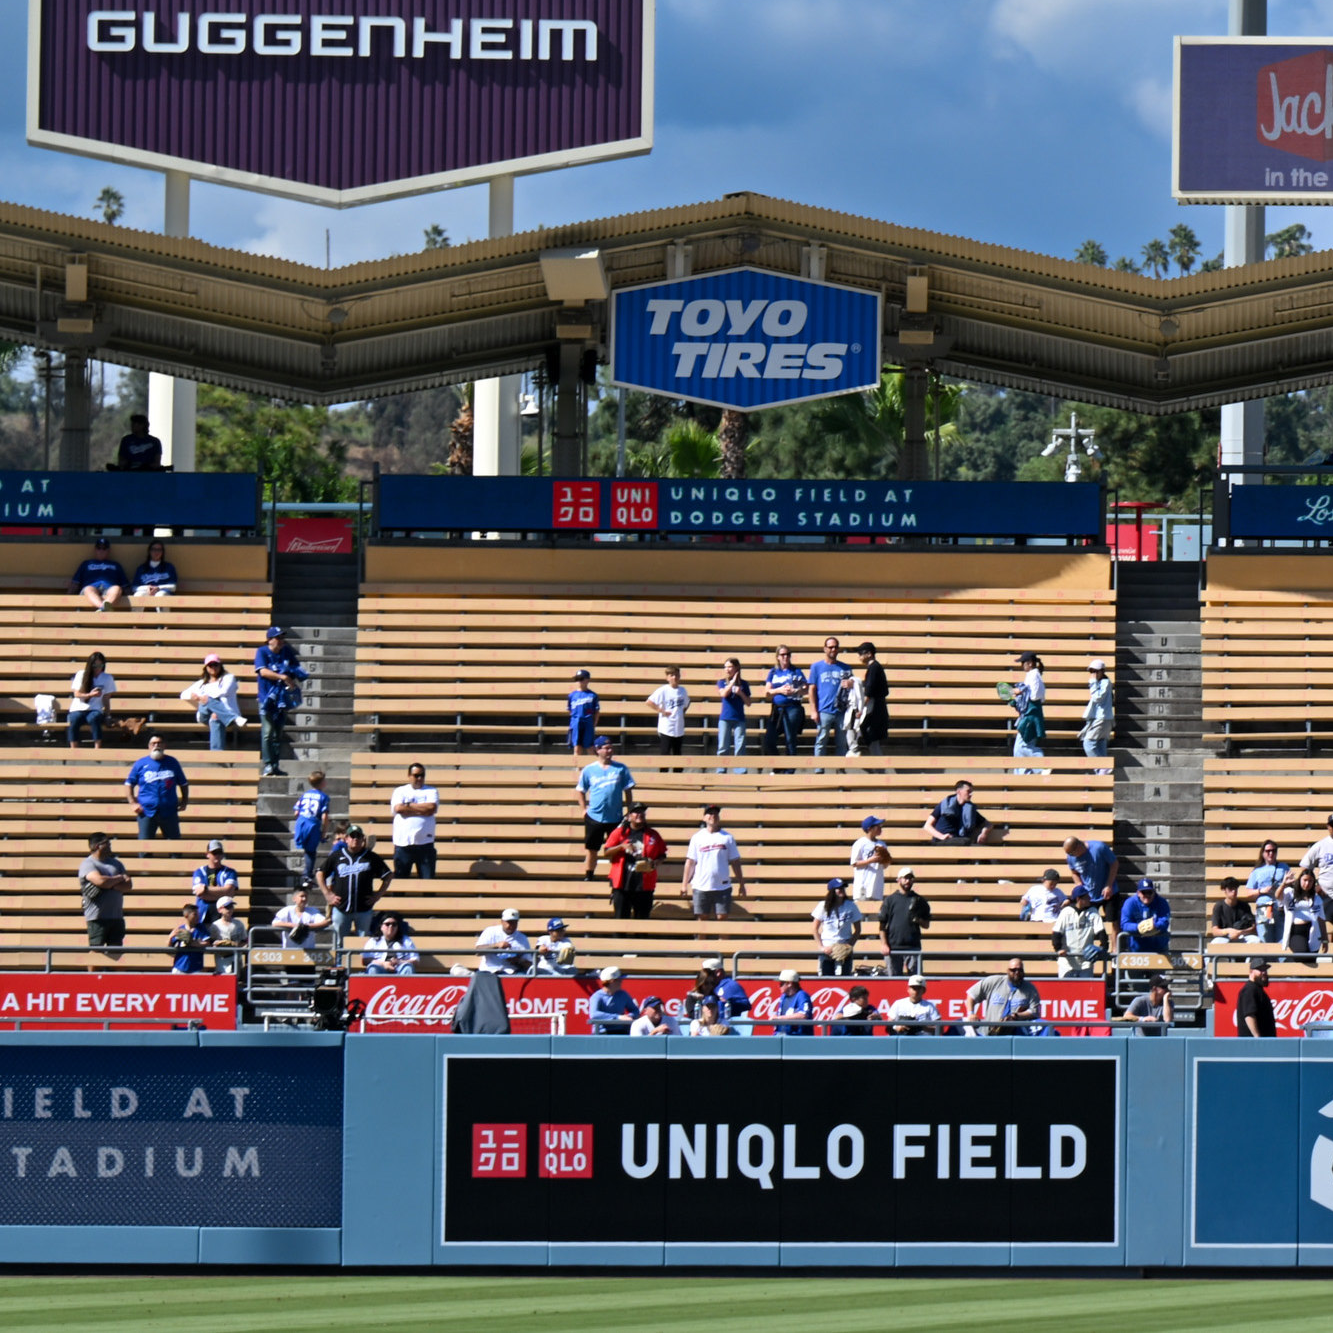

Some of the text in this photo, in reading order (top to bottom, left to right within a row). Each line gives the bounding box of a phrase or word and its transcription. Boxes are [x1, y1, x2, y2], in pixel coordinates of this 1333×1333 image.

[87, 10, 598, 61] GUGGENHEIM
[1265, 169, 1284, 187] in
[1291, 168, 1328, 187] the
[646, 299, 808, 337] TOYO
[671, 342, 848, 380] TIRES
[21, 479, 50, 493] AT
[671, 487, 914, 504] UNIQLO FIELD AT
[617, 488, 651, 504] UNI
[617, 507, 653, 524] QLO
[671, 511, 918, 528] DODGER STADIUM
[261, 952, 283, 963] 303
[1129, 956, 1150, 967] 305
[2, 993, 229, 1014] A HIT EVERY TIME
[1040, 1000, 1098, 1018] TIME
[183, 1087, 250, 1118] AT
[545, 1130, 584, 1150] UNI
[545, 1152, 588, 1175] QLO
[621, 1123, 1087, 1189] UNIQLO FIELD
